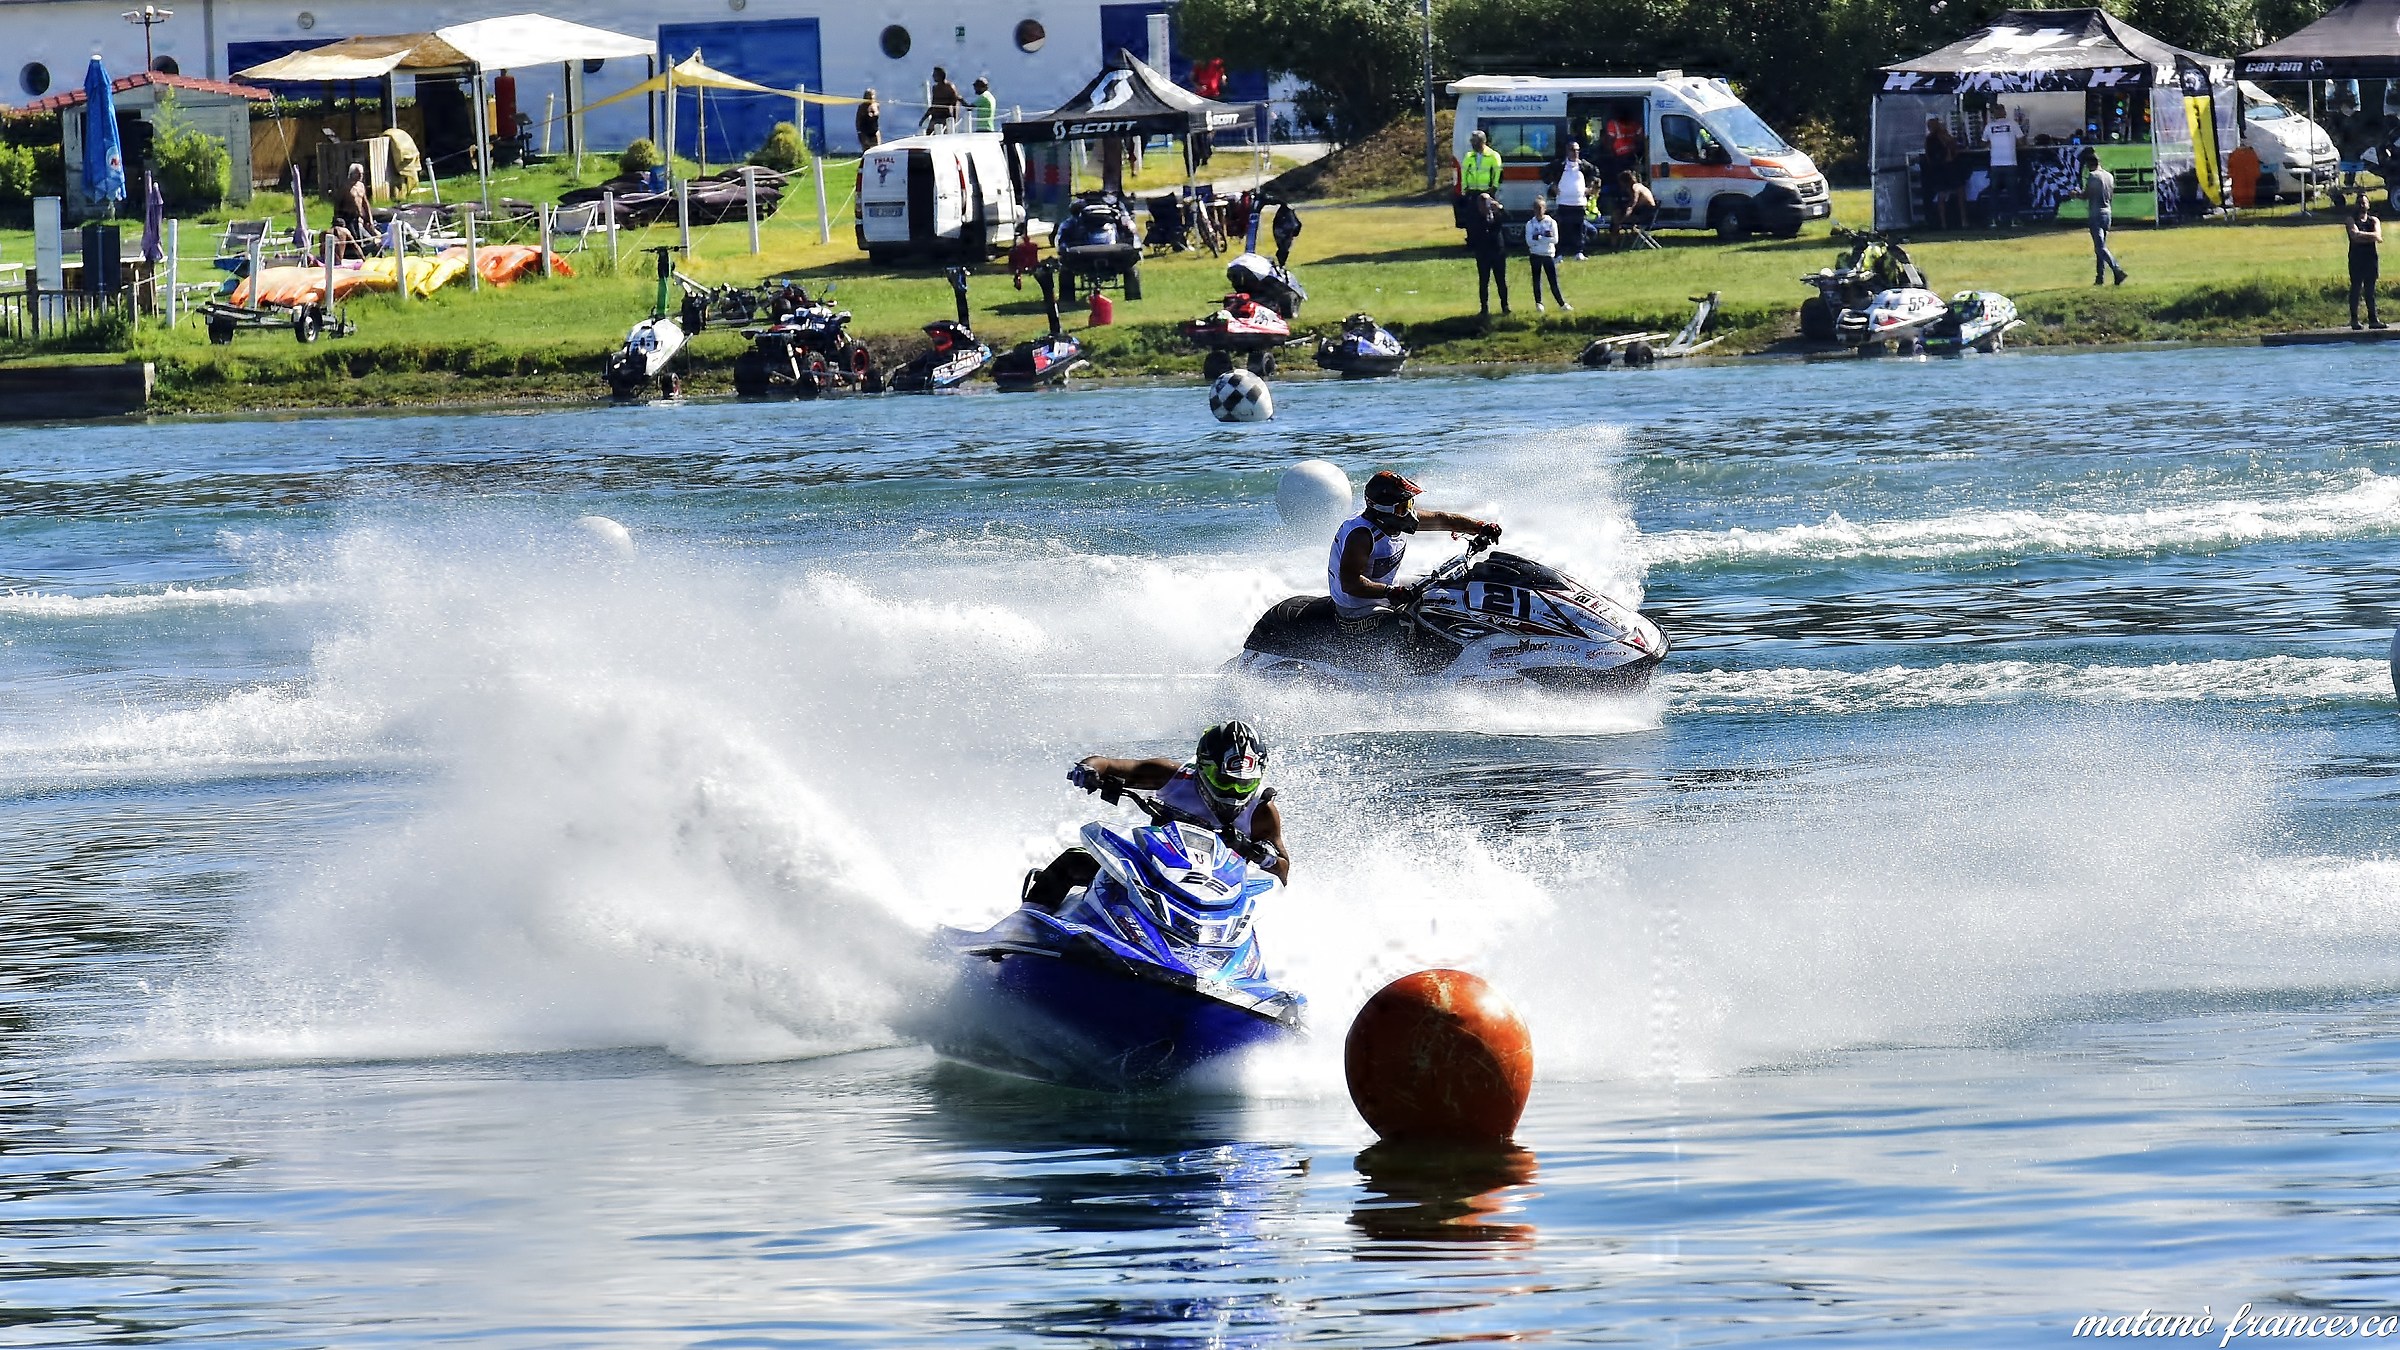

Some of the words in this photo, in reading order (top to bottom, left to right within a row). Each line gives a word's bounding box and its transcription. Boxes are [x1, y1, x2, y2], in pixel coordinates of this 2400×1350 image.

[1212, 113, 1240, 126] SCOTT
[1068, 120, 1138, 135] SCOTT
[1482, 583, 1531, 620] 21
